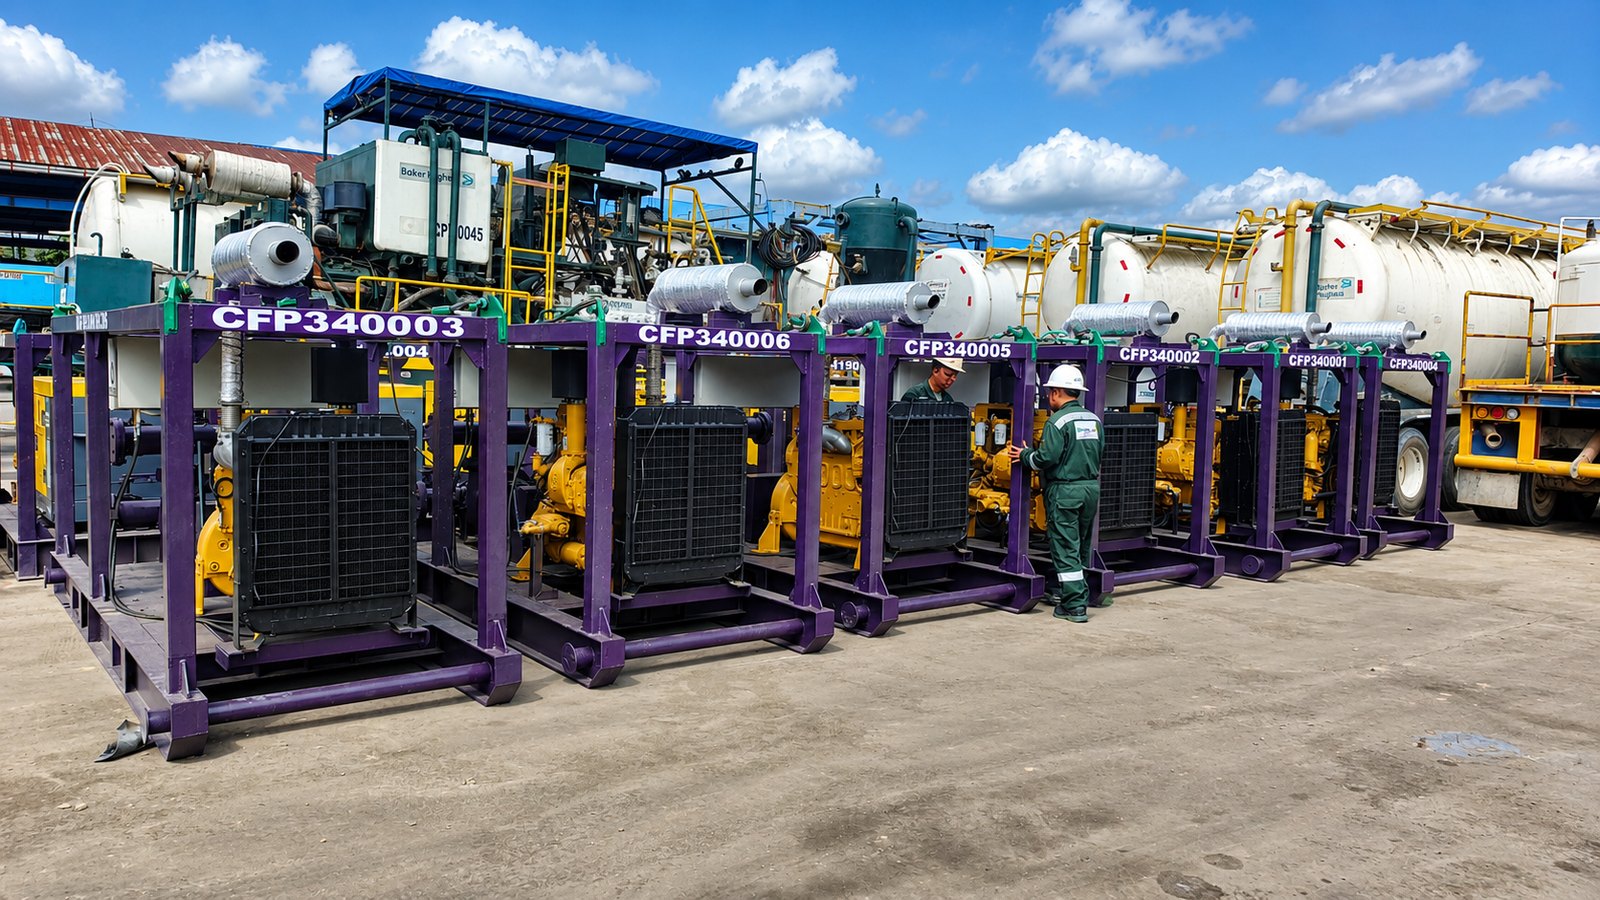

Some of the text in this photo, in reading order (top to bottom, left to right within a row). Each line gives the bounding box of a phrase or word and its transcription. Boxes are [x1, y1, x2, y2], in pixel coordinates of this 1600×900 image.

[401, 167, 426, 178] Baker
[212, 307, 465, 337] CFP340003
[638, 325, 790, 349] CFP340006
[905, 340, 1011, 358] CFP340005
[1120, 348, 1200, 364] CFP340002
[1289, 355, 1346, 367] CFP340001
[1390, 358, 1438, 371] CFP340004
